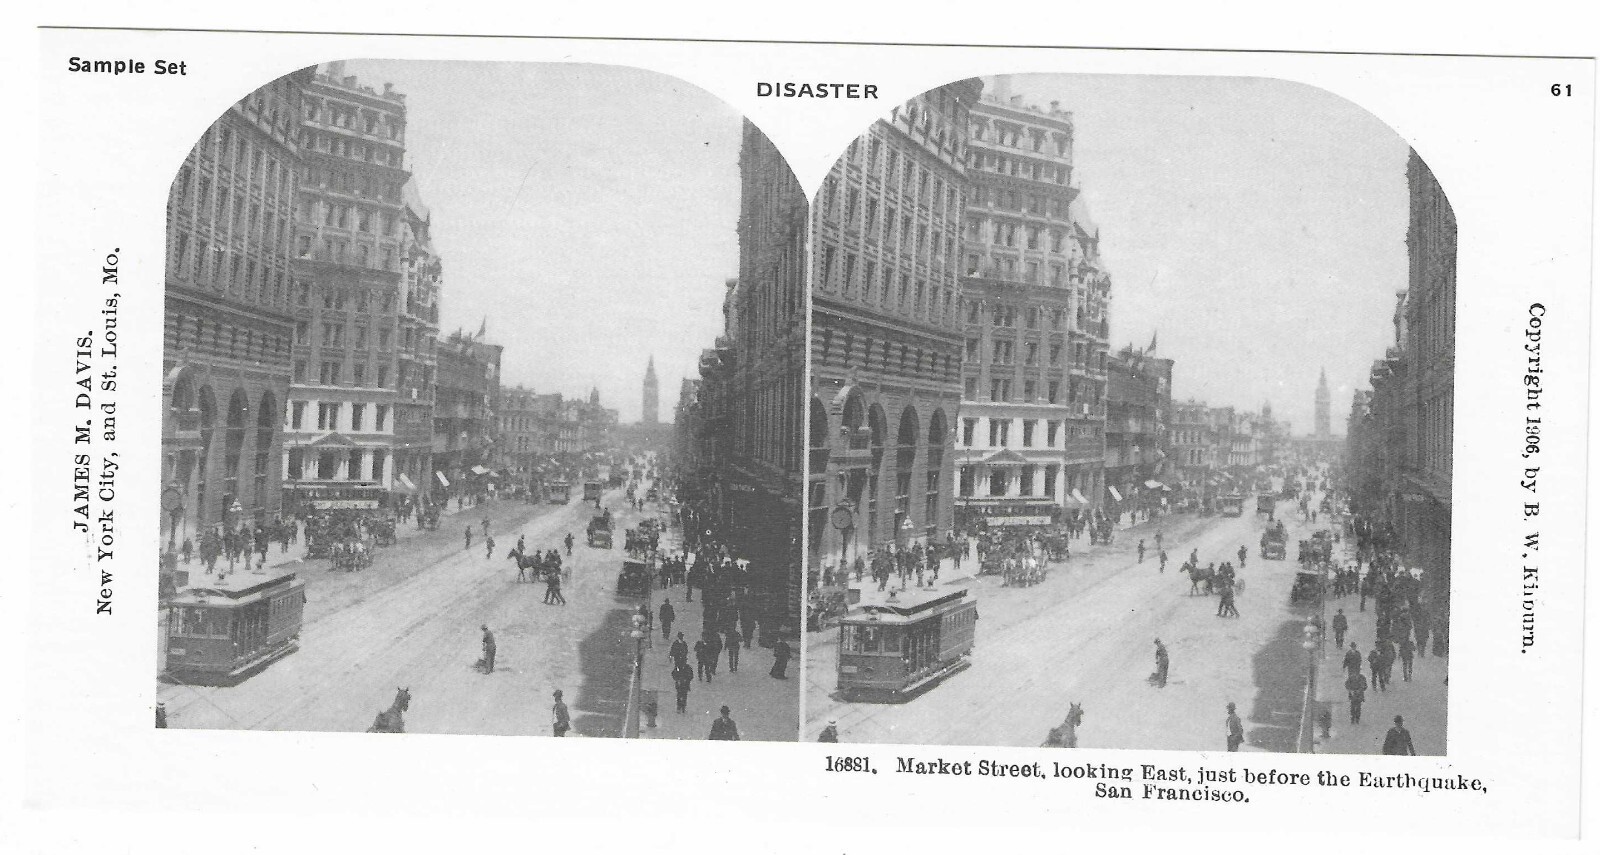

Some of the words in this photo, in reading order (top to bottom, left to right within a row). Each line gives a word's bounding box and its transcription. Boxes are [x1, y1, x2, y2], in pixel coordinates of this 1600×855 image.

[68, 57, 145, 75] Sample
[154, 59, 187, 75] Set
[757, 82, 879, 99] DISASTER
[1550, 83, 1572, 97] 61
[102, 247, 121, 285] Mo.
[101, 292, 122, 358] Louis,
[75, 330, 93, 410] DAVIS.
[1523, 302, 1546, 411] Copyright
[100, 365, 118, 392] St.
[75, 419, 92, 445] M.
[100, 401, 116, 442] and
[1521, 416, 1542, 459] 1906,
[73, 454, 91, 533] JAMES
[98, 452, 121, 502] City,
[1520, 466, 1540, 494] by
[97, 509, 114, 563] York
[1522, 531, 1540, 559] W.
[96, 568, 114, 616] New
[896, 756, 972, 776] Market
[1053, 761, 1134, 782] looking
[1140, 764, 1192, 785] East,
[1197, 766, 1237, 785] just
[1243, 768, 1310, 786] before
[1317, 770, 1351, 787] the
[1358, 771, 1487, 794] Earthquake,
[1095, 782, 1132, 799] San
[1142, 783, 1250, 804] Francisco.
